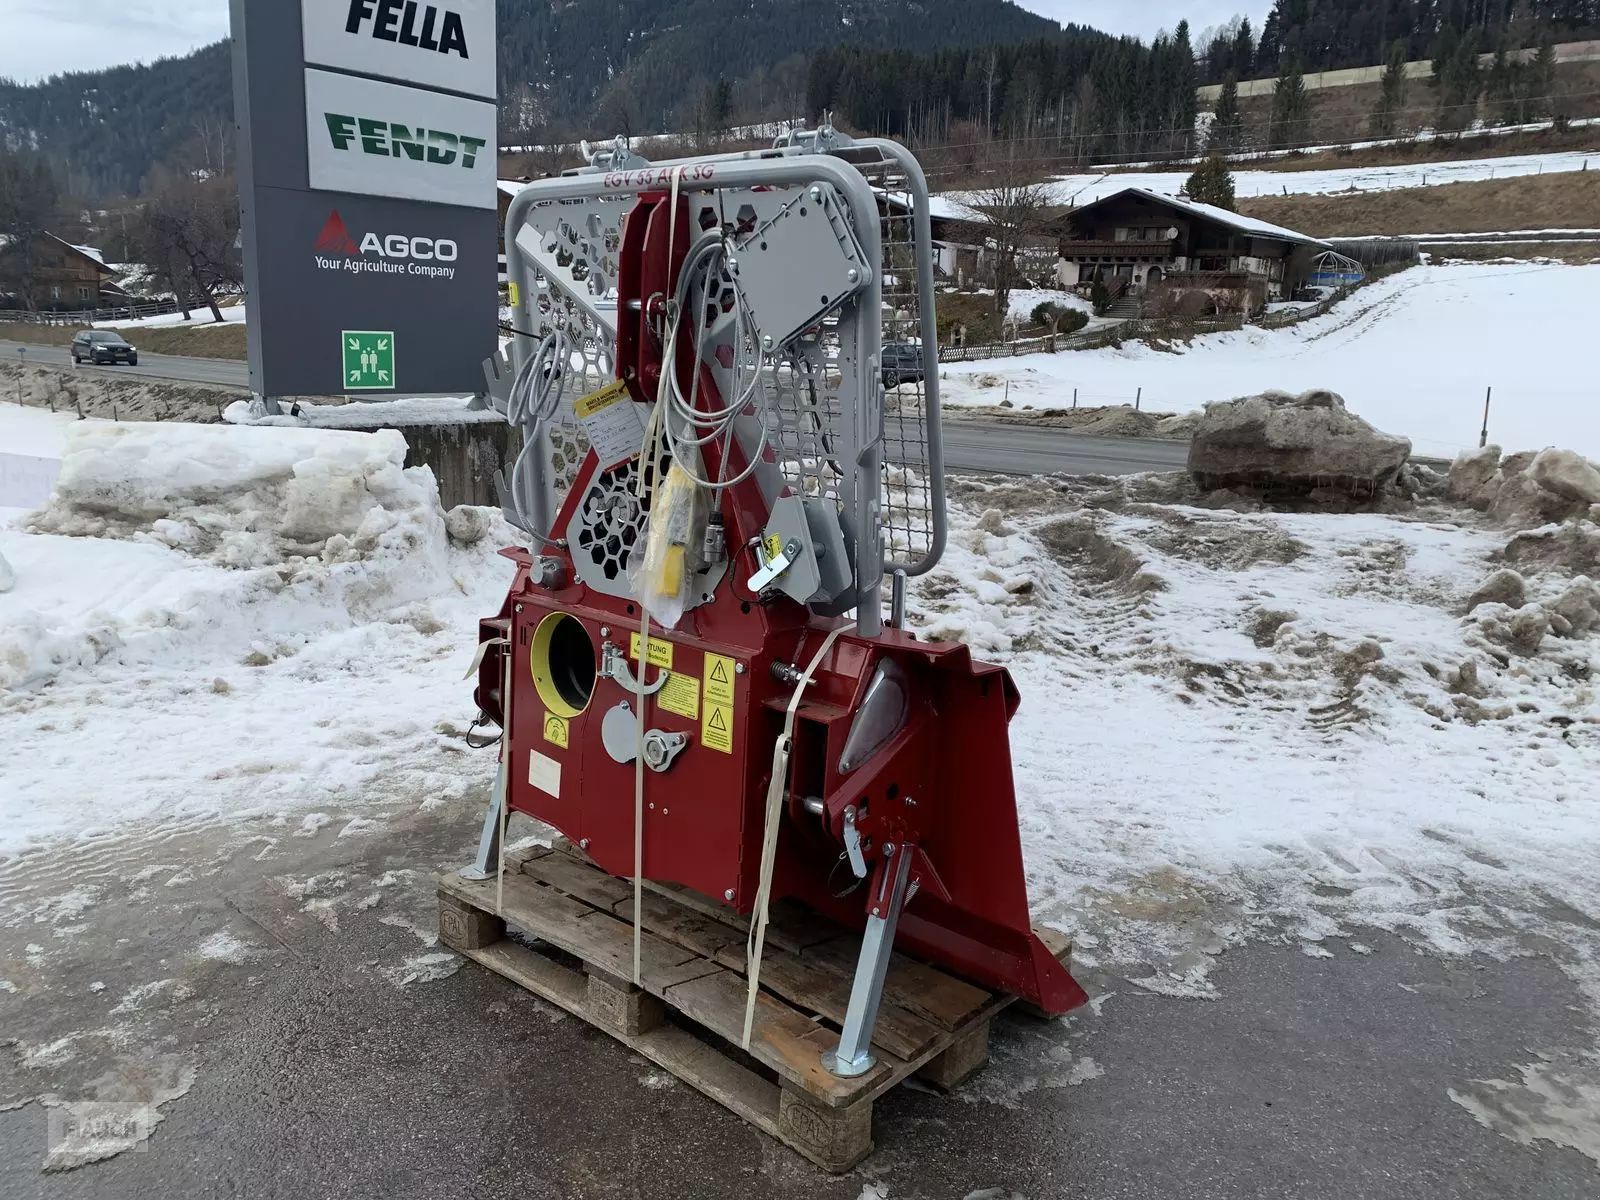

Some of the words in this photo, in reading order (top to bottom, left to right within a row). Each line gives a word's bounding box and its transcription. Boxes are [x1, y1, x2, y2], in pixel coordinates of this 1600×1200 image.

[345, 0, 469, 59] FELLA
[324, 112, 487, 169] FENDT
[604, 171, 633, 188] EGV
[692, 164, 715, 181] SG
[360, 232, 458, 262] AGCO
[315, 256, 341, 270] Your
[343, 258, 405, 274] Agriculture
[407, 262, 455, 279] Company
